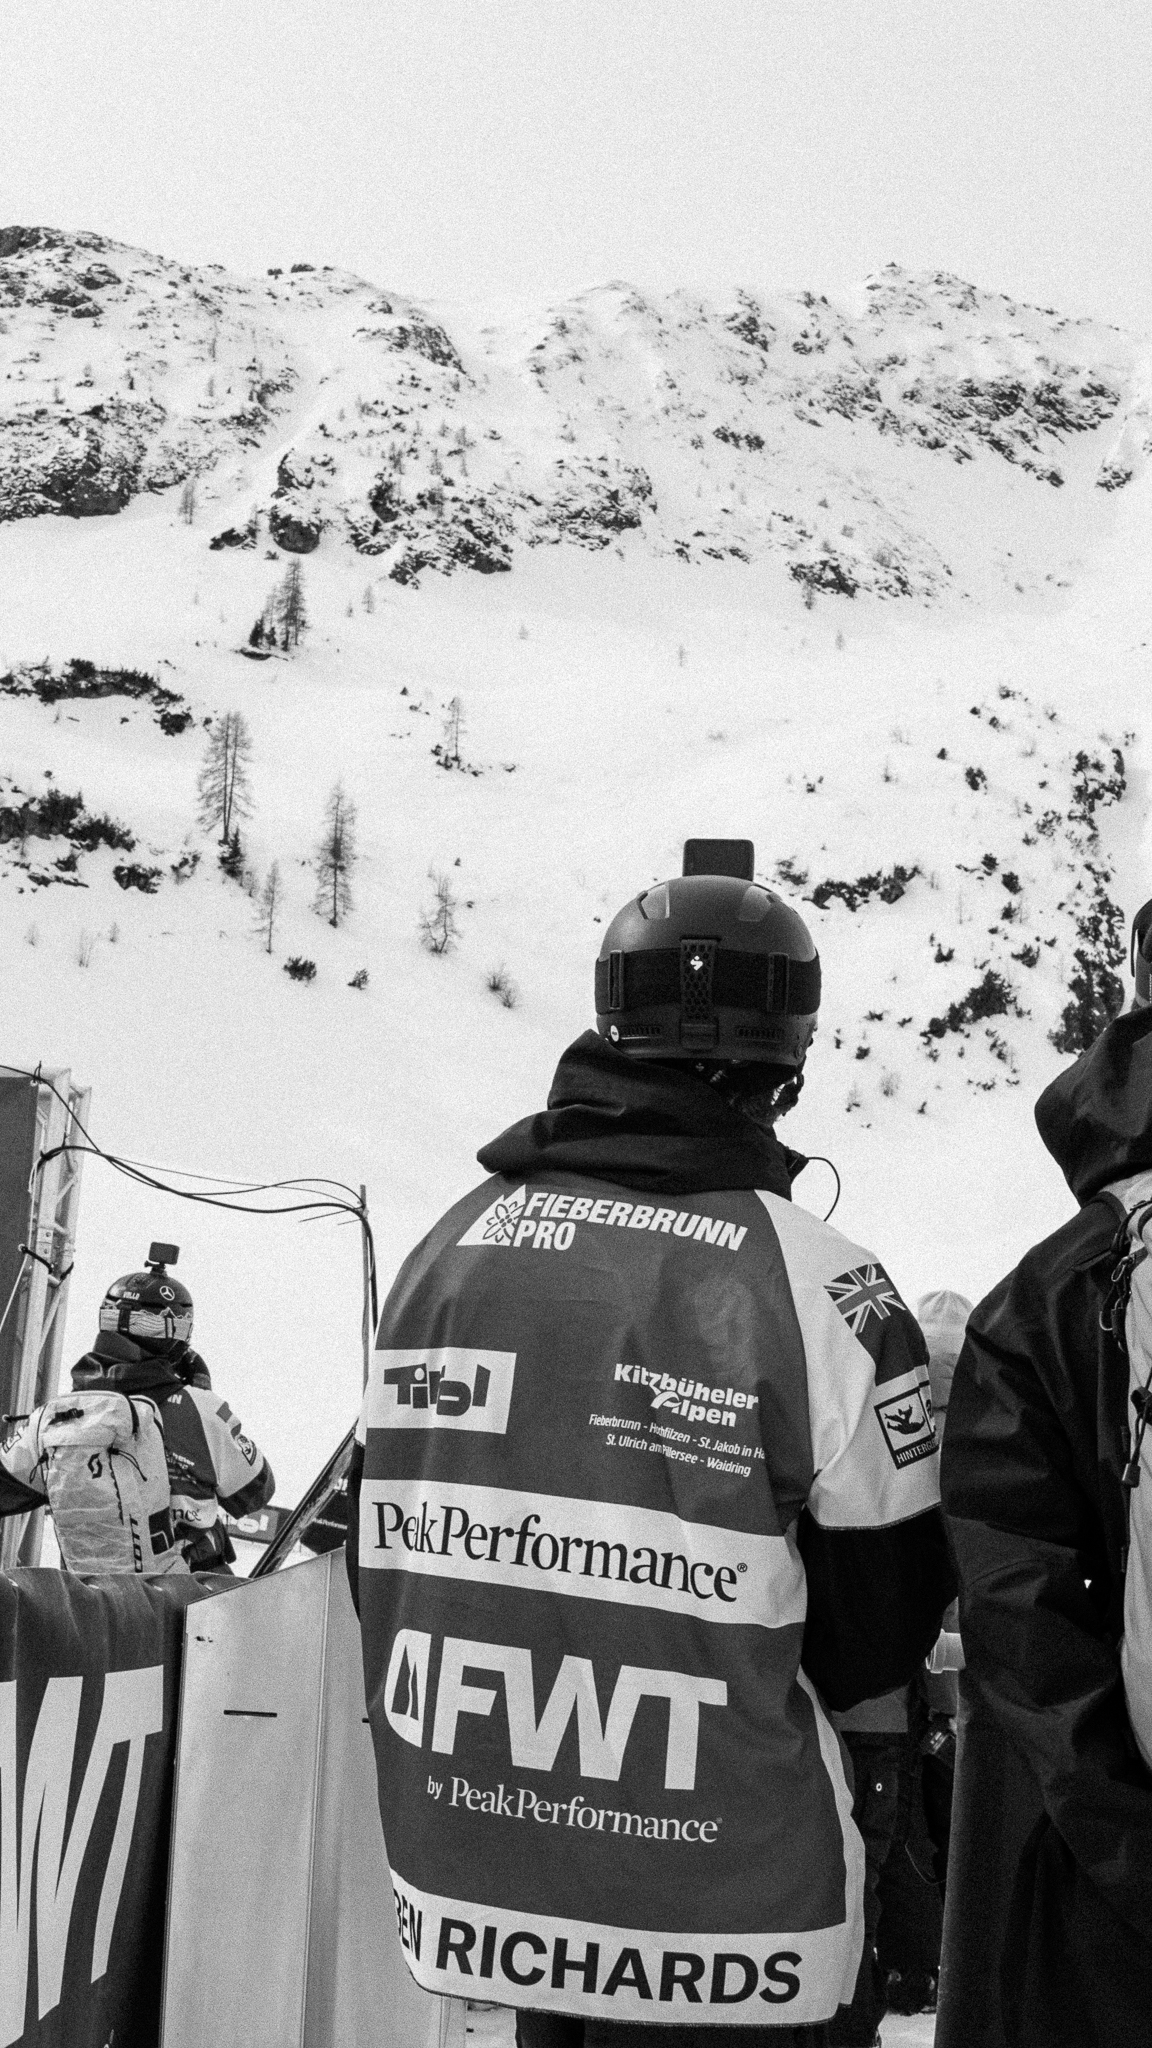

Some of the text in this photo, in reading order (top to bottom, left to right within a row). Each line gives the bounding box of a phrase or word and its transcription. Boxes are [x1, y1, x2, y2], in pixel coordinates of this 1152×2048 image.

[513, 1219, 577, 1251] PRO
[523, 1192, 749, 1251] FIEBERBRUNN
[613, 1363, 759, 1410] Kitzbüheler
[650, 1390, 737, 1428] Alpen
[588, 1413, 642, 1432] Fieberbrunn
[697, 1436, 712, 1450] St.
[712, 1439, 740, 1456] Jakob
[741, 1443, 752, 1458] in
[605, 1433, 617, 1446] St.
[618, 1435, 648, 1451] Ulrich
[706, 1456, 752, 1478] Waidring
[129, 1513, 144, 1573] COTT
[431, 1635, 728, 1791] FWT
[427, 1775, 443, 1800] by
[0, 1664, 164, 2048] WT
[435, 1916, 803, 2005] RICHARDS
